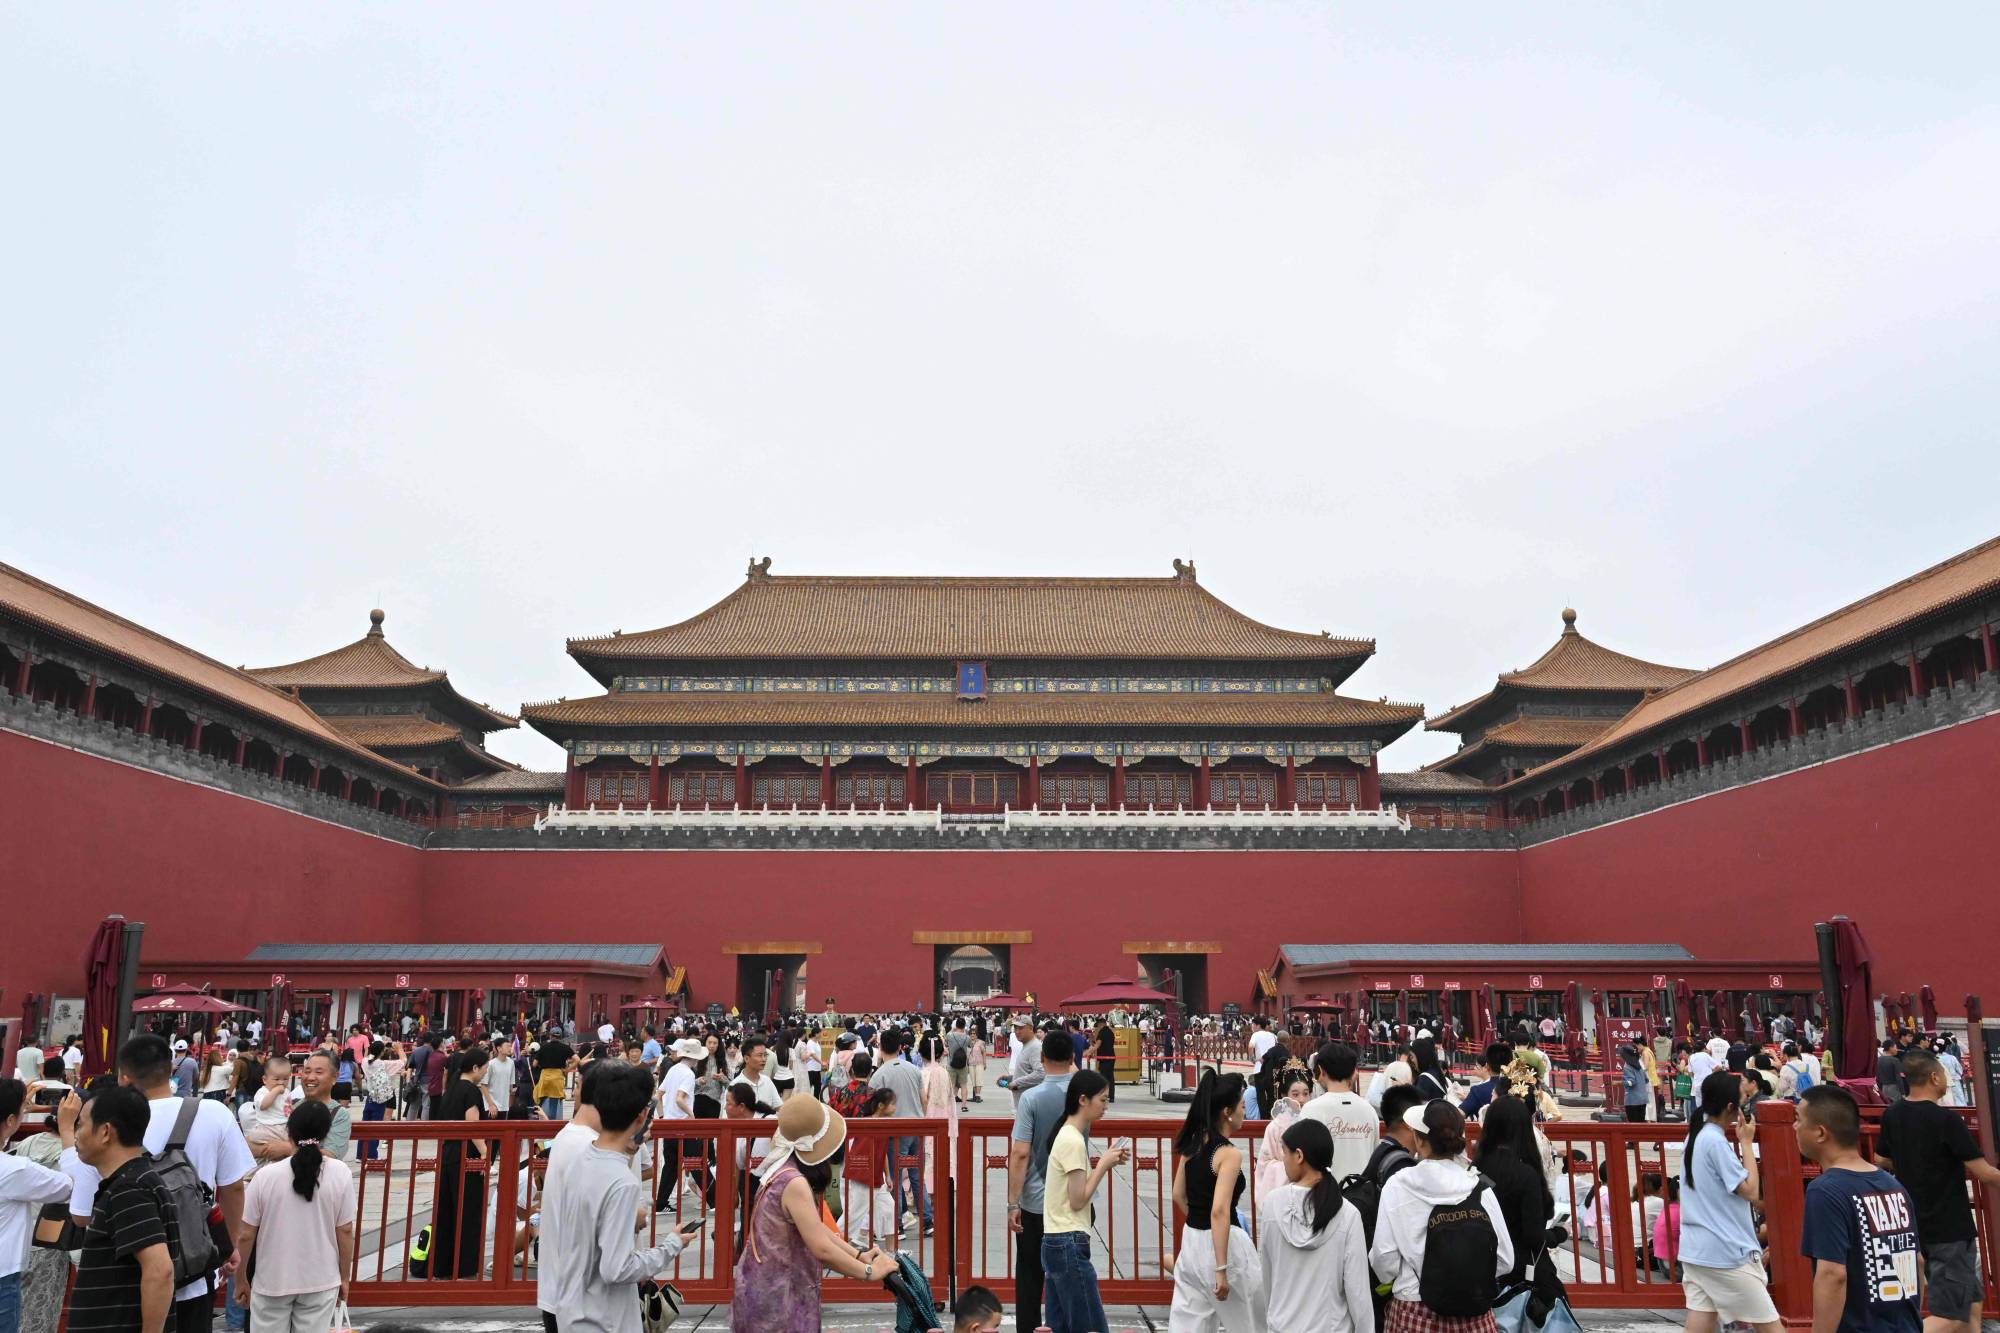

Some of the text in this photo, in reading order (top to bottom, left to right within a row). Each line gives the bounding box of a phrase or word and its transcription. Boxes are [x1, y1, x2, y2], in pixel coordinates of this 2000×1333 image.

[517, 976, 525, 985] 4
[1414, 976, 1421, 986] 5
[1533, 976, 1540, 986] 6
[1656, 976, 1663, 986] 7
[1428, 1209, 1491, 1229] OUTDOOR SPO
[1863, 1192, 1910, 1232] VANS
[1887, 1232, 1916, 1251] THE
[1872, 1237, 1904, 1302] OFF
